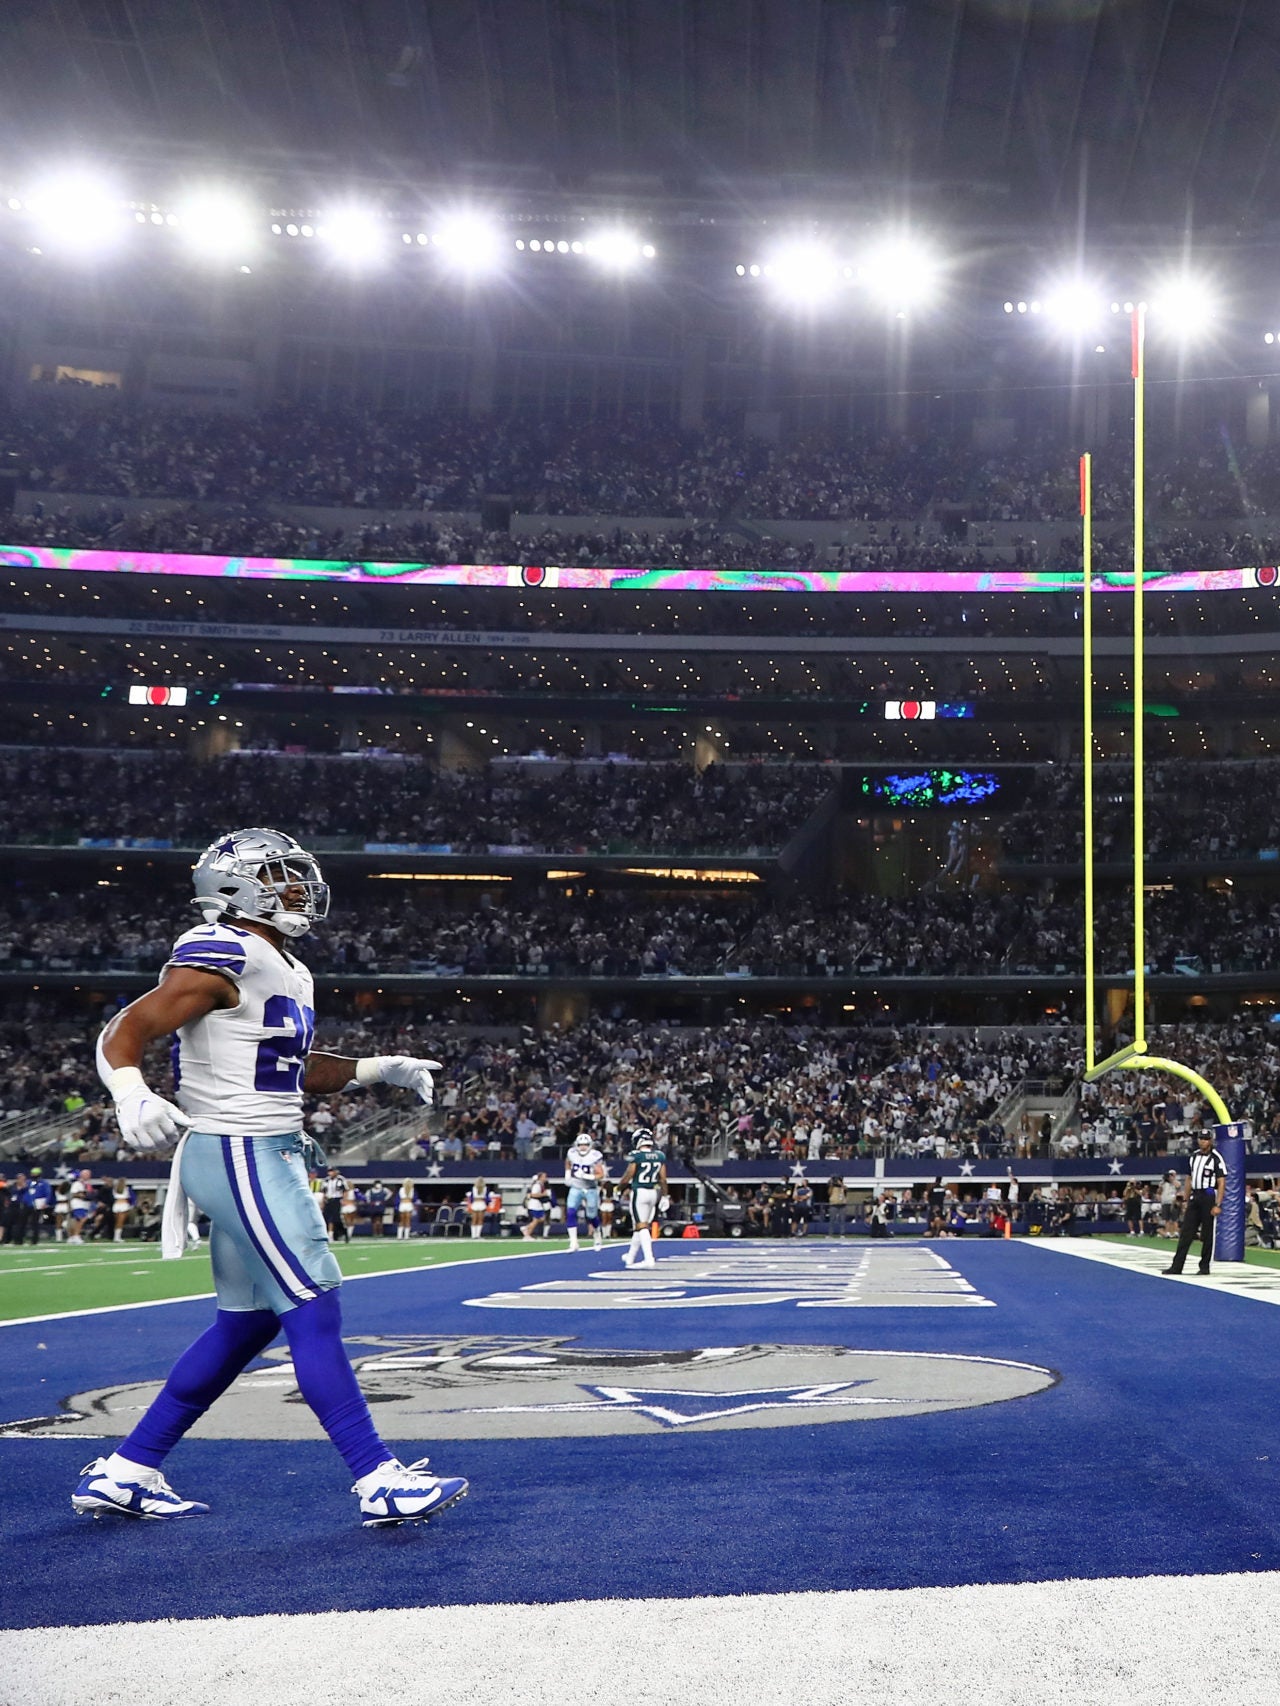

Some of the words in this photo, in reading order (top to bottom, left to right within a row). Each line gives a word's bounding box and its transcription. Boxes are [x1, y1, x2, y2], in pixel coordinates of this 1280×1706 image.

[147, 623, 194, 635] EMMITT
[200, 625, 239, 636] SMITH
[400, 632, 438, 642] LARRY
[442, 633, 480, 643] ALLEN
[638, 1161, 662, 1184] 22
